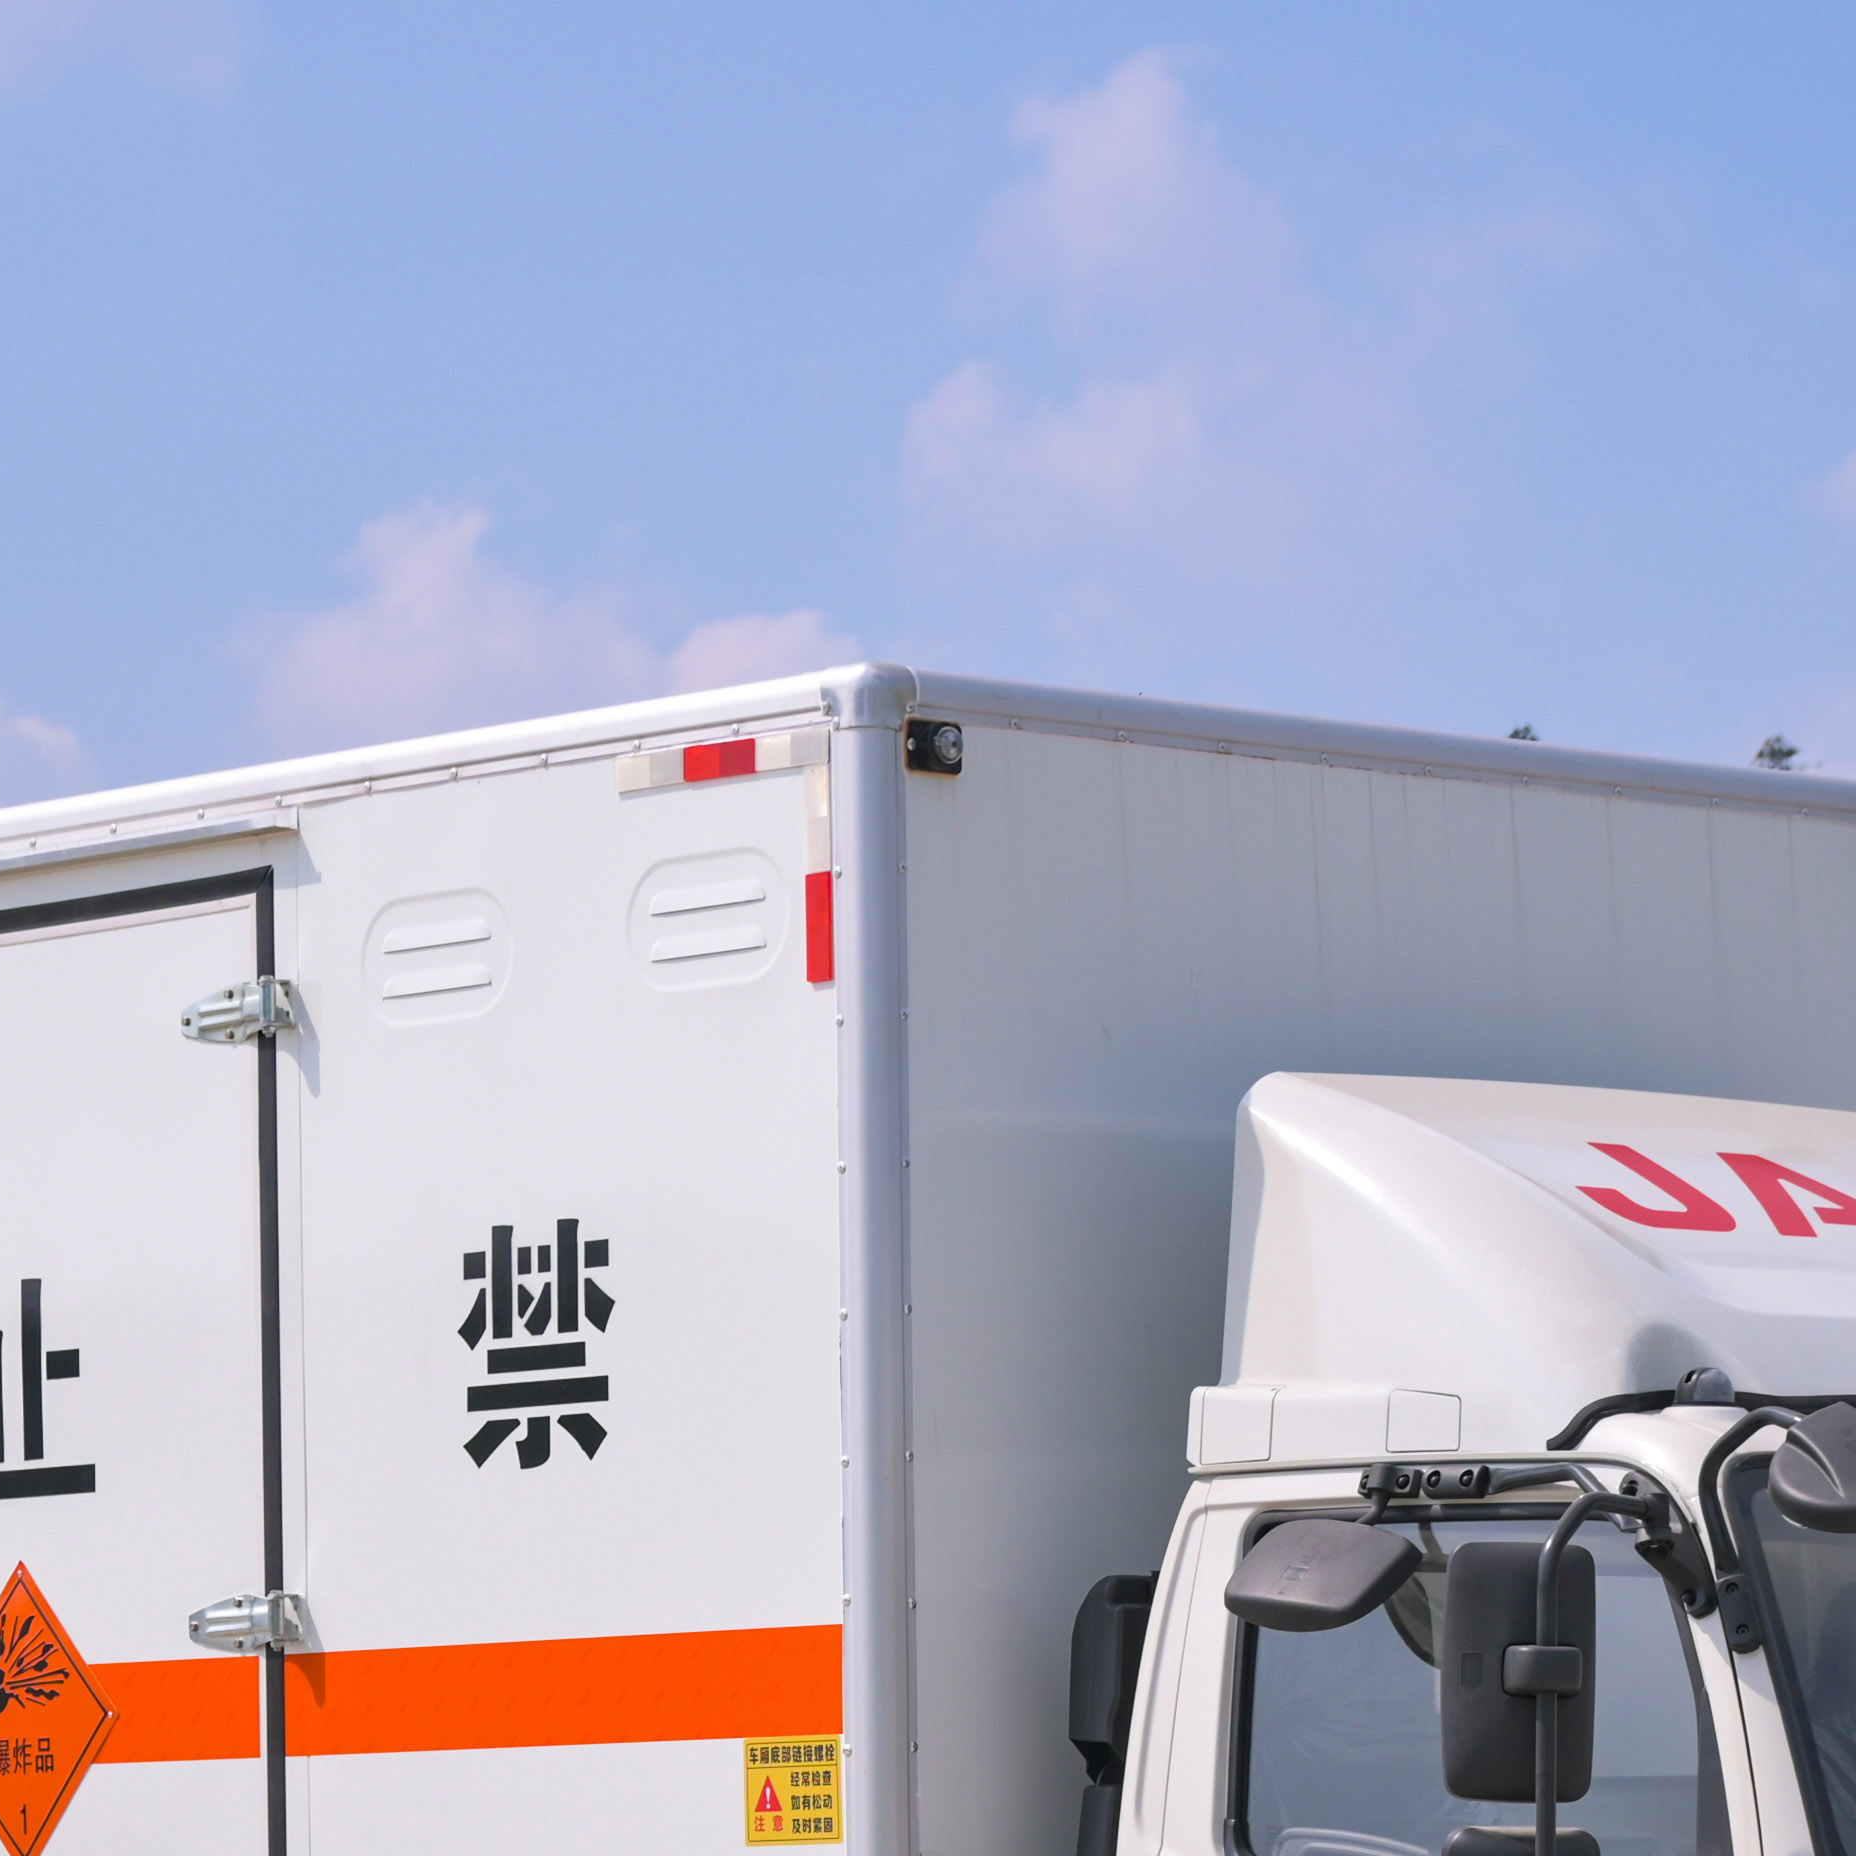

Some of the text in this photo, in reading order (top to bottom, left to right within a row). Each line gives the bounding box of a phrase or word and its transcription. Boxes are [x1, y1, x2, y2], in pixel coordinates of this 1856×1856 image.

[457, 1217, 617, 1471] 禁
[748, 1743, 835, 1766] 车厢底部链接螺栓
[790, 1770, 832, 1788] 经常检查
[790, 1794, 833, 1811] 如有松动
[19, 1803, 28, 1835] 1
[754, 1815, 784, 1833] 注意
[791, 1816, 834, 1834] 及时紧固
